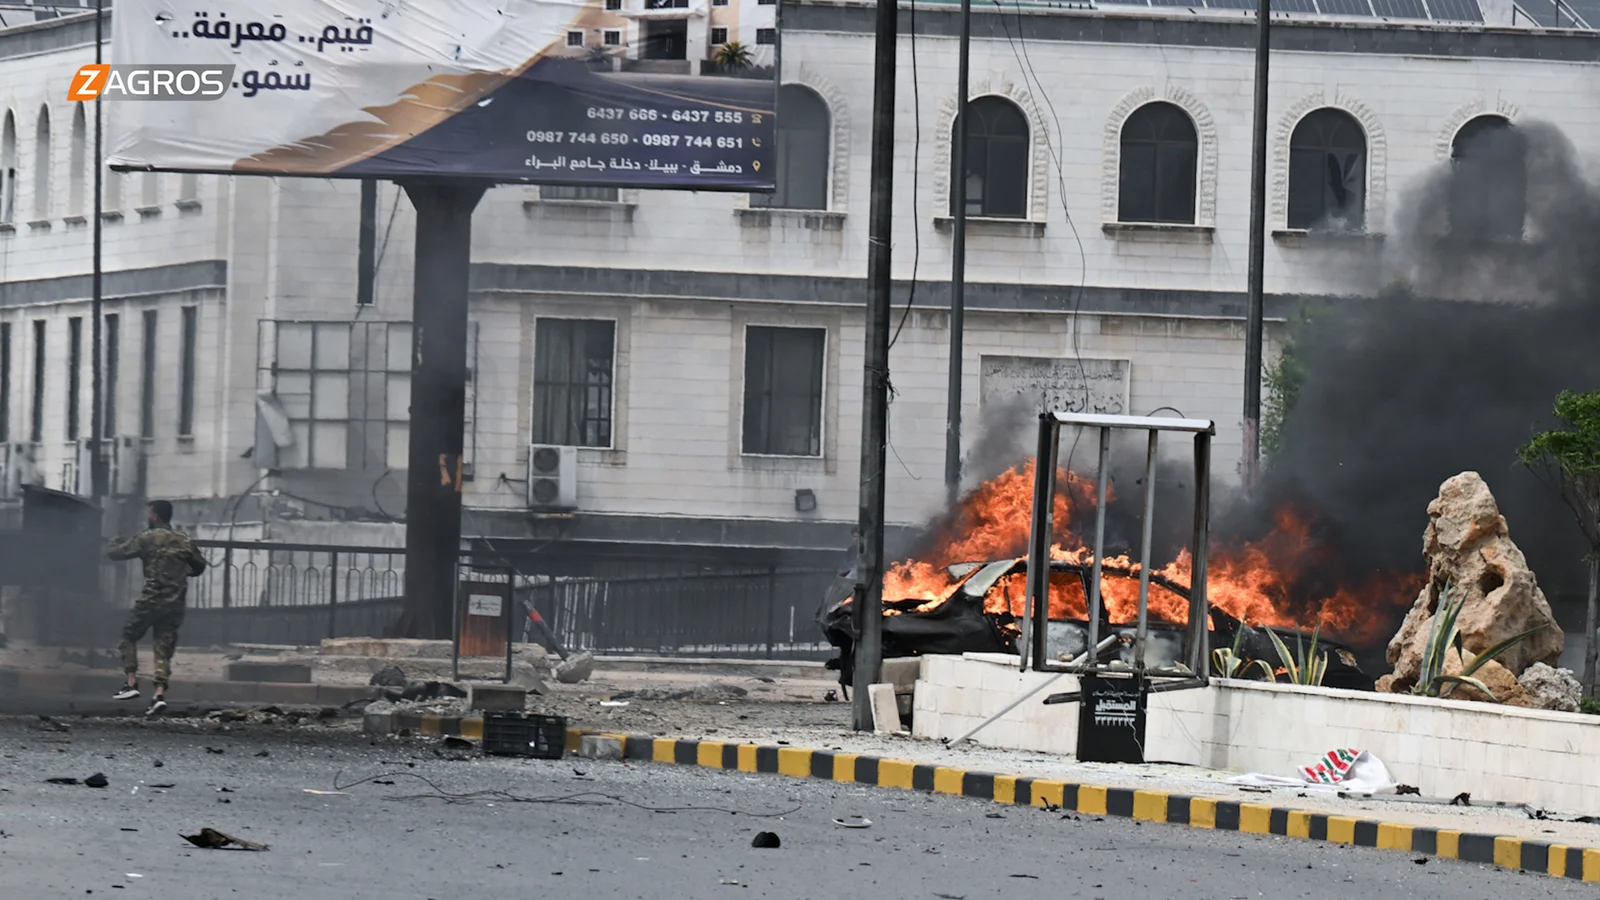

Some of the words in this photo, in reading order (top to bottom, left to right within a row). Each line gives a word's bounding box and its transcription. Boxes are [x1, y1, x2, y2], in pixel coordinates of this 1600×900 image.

[587, 107, 624, 120] 6437
[629, 108, 657, 121] 666
[671, 110, 709, 122] 6437
[714, 111, 743, 123] 555
[526, 130, 563, 143] 0987
[568, 132, 597, 144] 744
[600, 133, 629, 145] 650
[642, 134, 680, 147] 0987
[684, 135, 713, 148] 744
[716, 136, 743, 149] 651
[525, 154, 566, 170] البراء
[569, 156, 606, 171] جامع
[609, 157, 641, 170] دخلة
[1095, 699, 1136, 711] المستقبل
